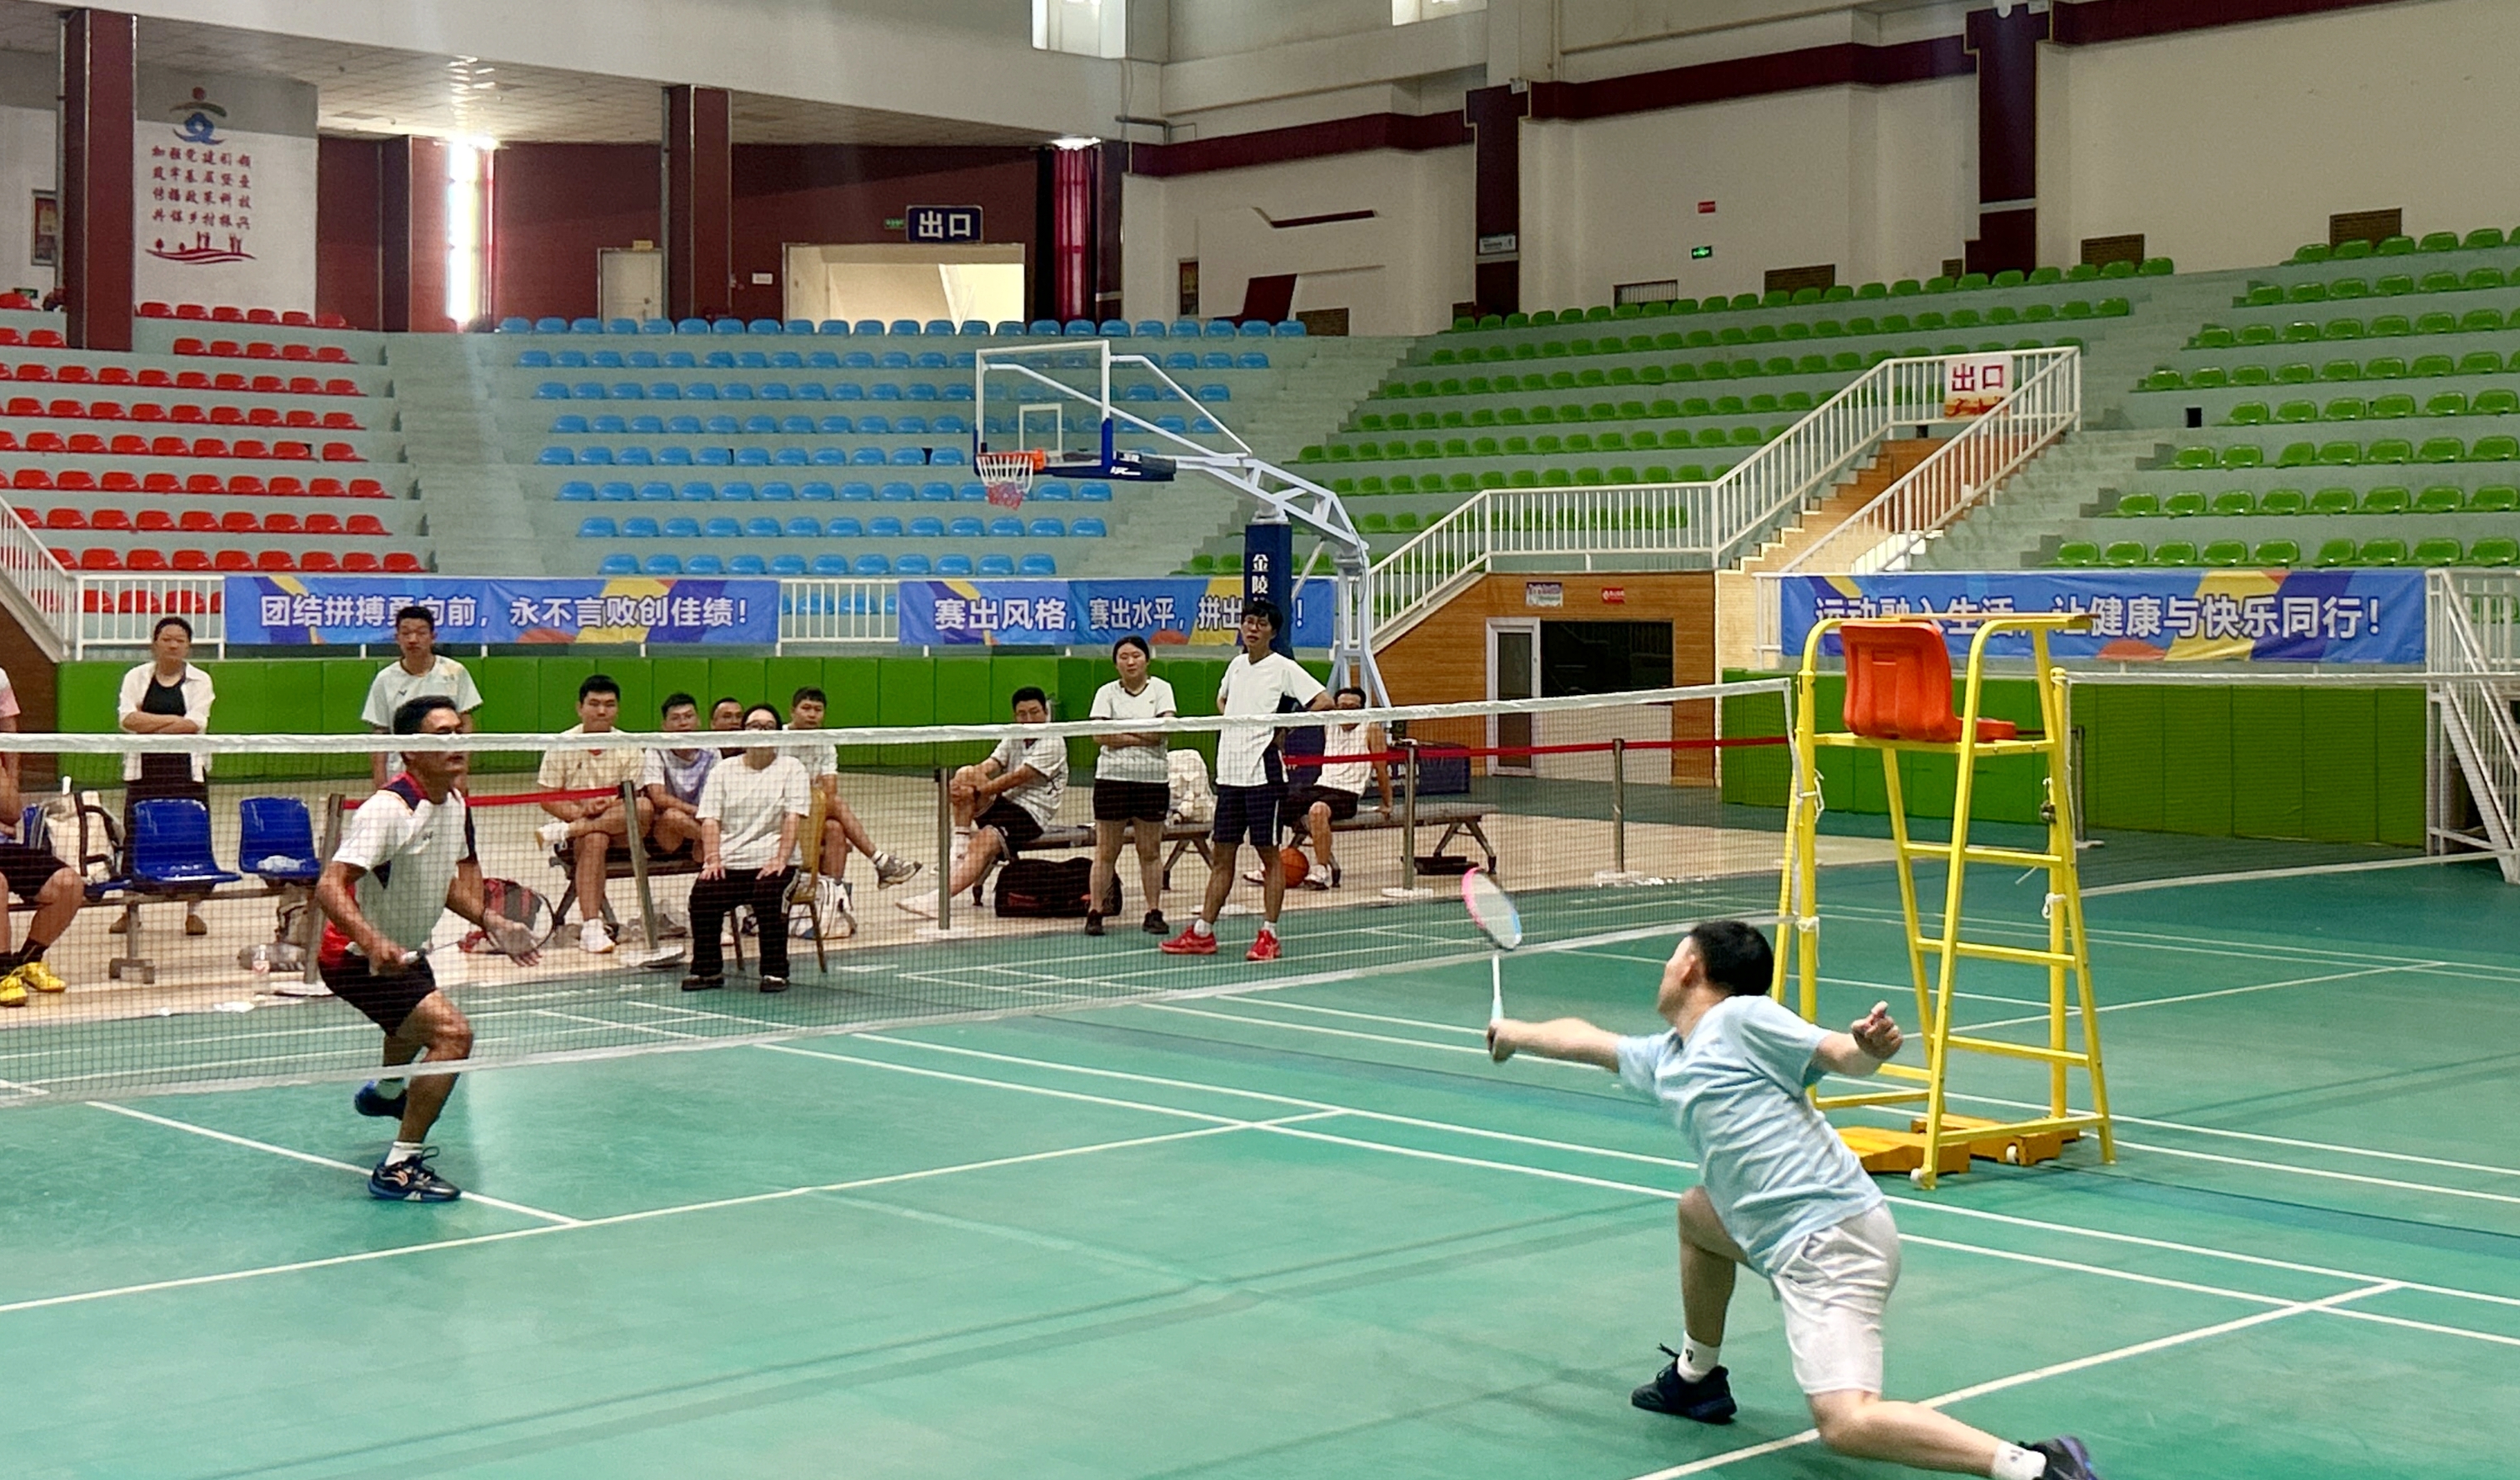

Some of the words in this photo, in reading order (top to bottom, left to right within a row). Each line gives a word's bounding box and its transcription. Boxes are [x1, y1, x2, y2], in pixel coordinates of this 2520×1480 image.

[918, 210, 971, 238] 出口
[1952, 363, 2003, 392] 出口
[1252, 553, 1268, 602] 金陵
[935, 597, 1302, 631] 赛出风格，赛出水平，拼出！
